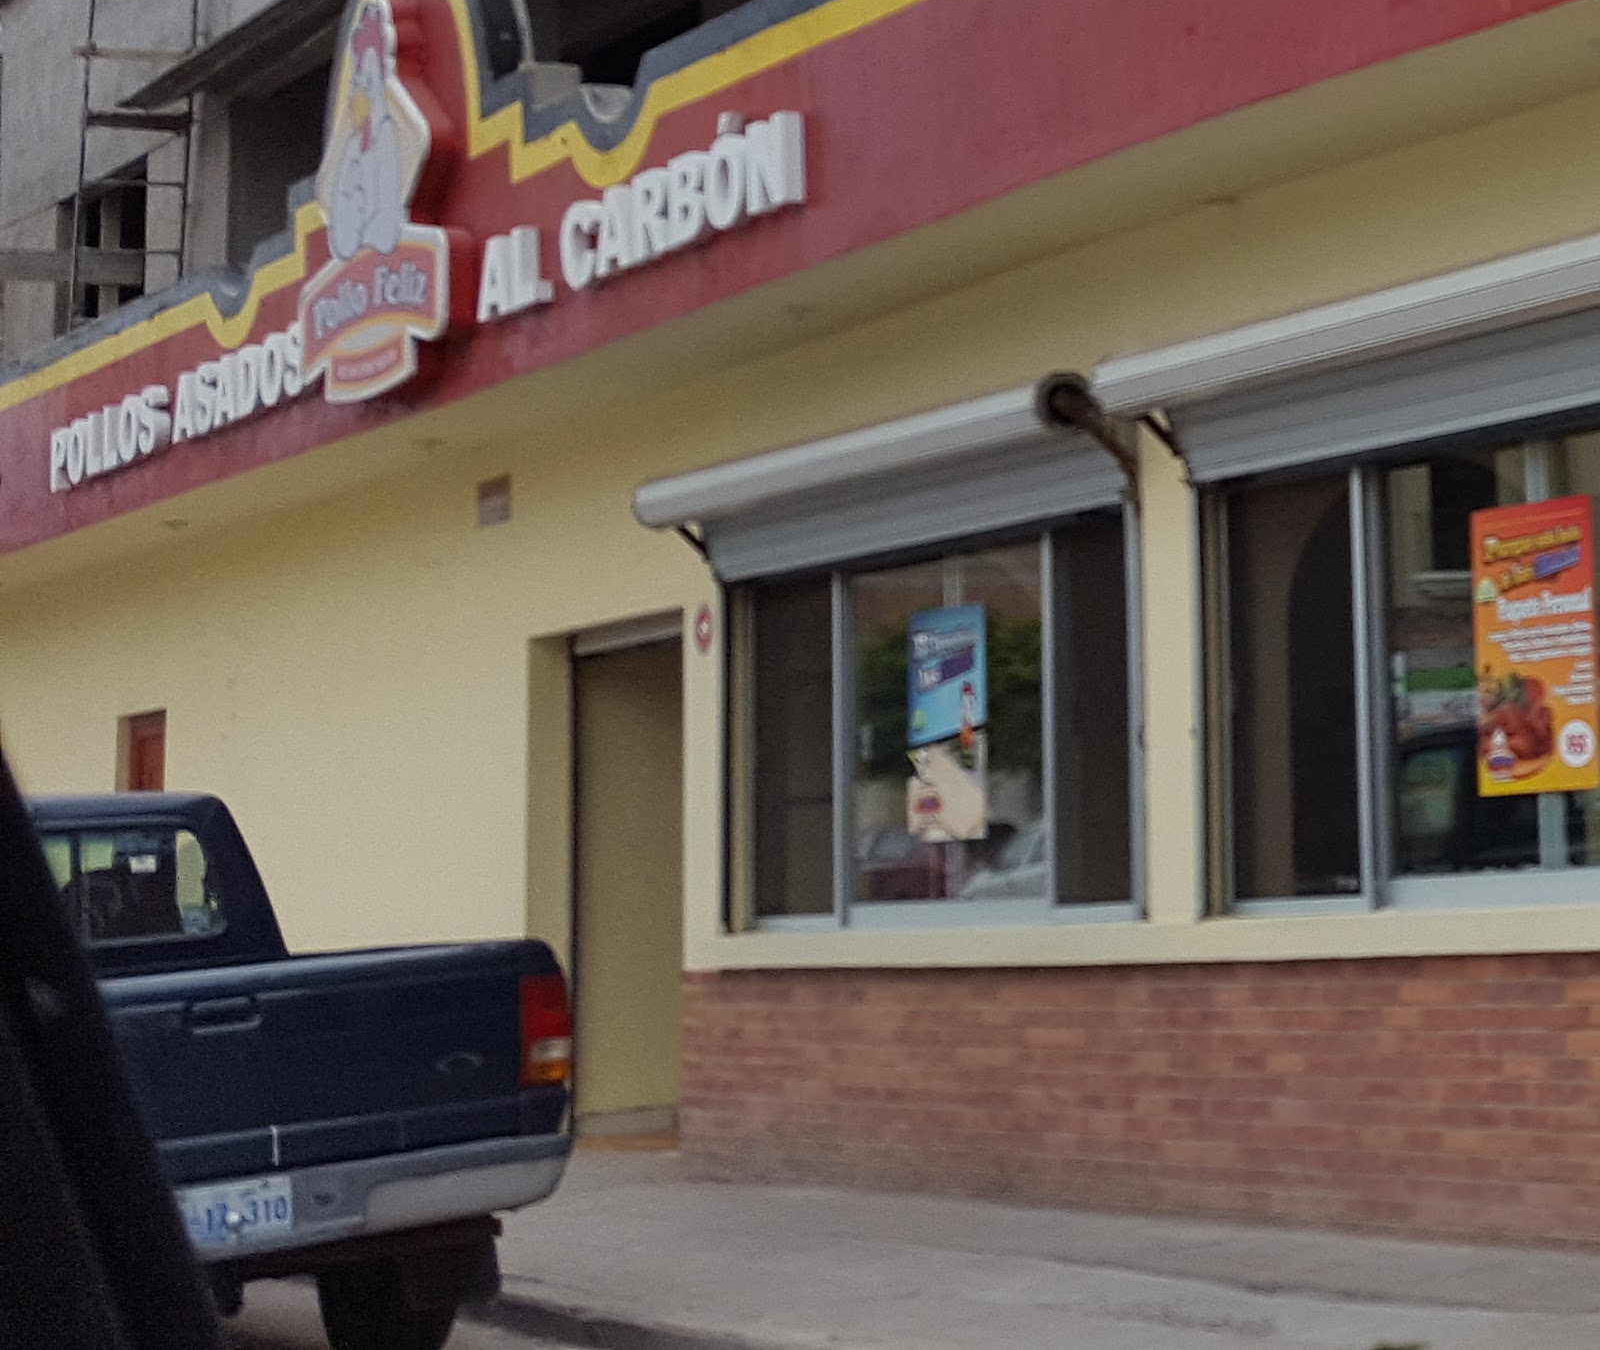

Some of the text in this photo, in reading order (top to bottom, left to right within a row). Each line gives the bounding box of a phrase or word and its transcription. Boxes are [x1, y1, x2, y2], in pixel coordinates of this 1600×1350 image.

[476, 109, 807, 323] AL CARBÓN
[50, 383, 172, 494] POLLOS
